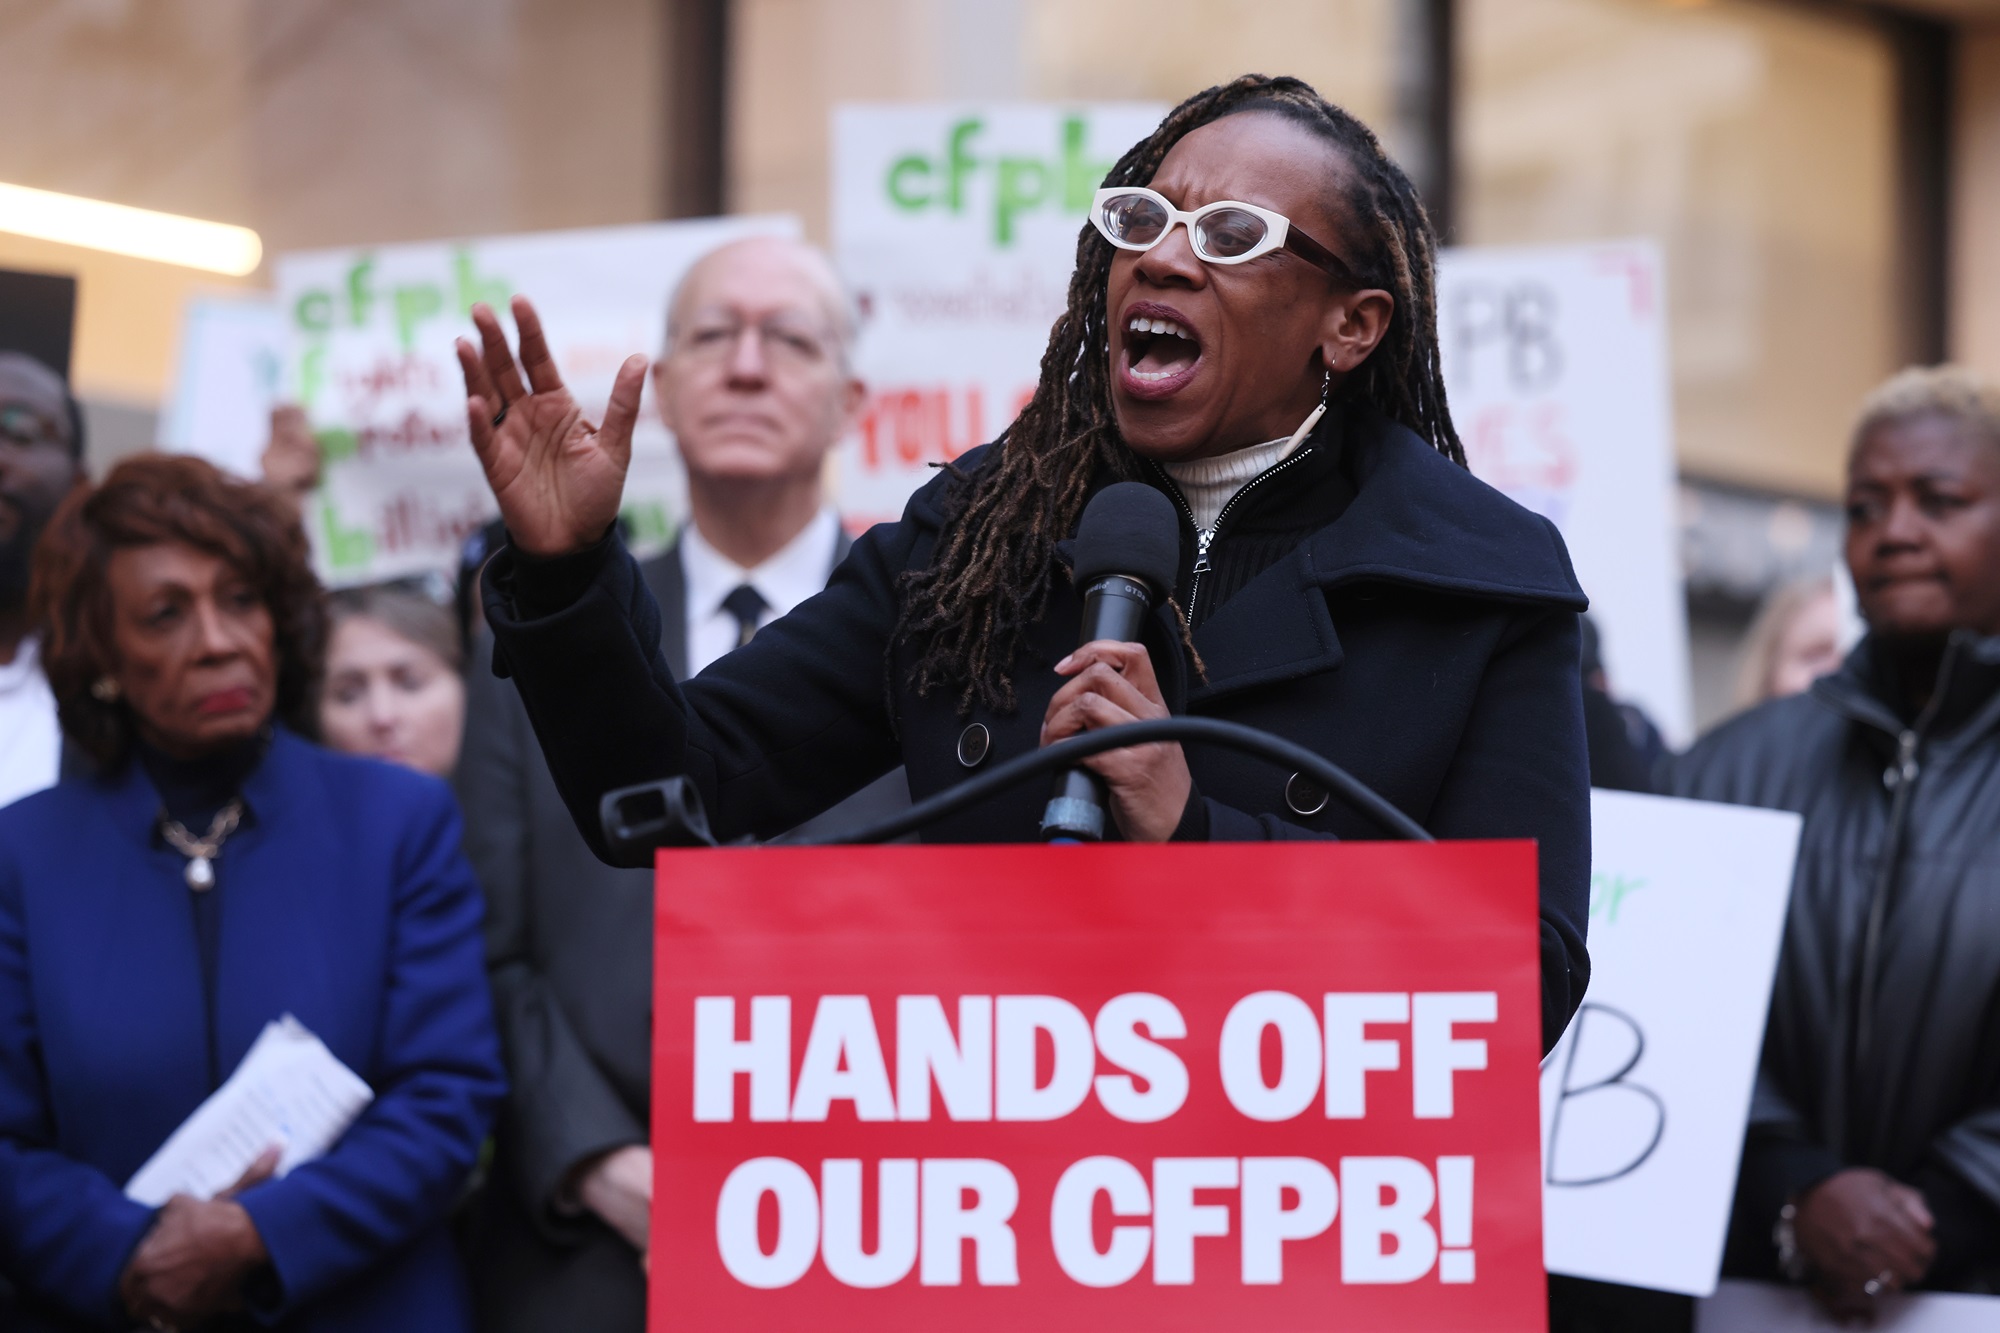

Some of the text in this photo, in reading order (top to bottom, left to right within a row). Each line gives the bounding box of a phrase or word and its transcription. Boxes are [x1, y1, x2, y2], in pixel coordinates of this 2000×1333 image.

[693, 990, 1498, 1123] HANDS OFF
[716, 1155, 1476, 1289] OUR CFPB!
